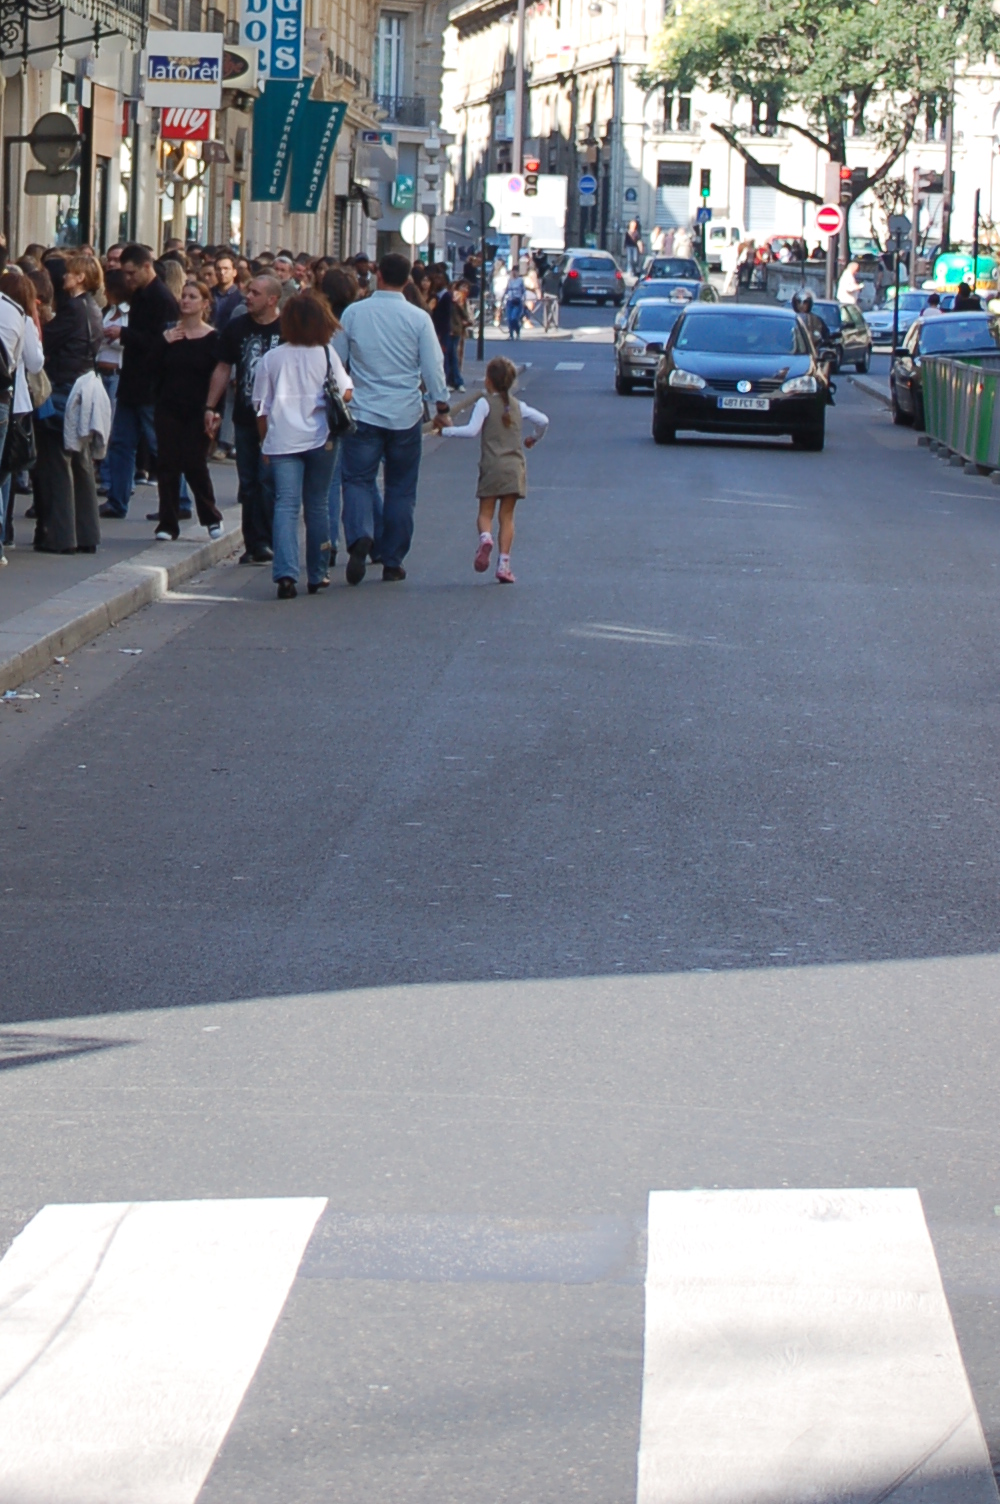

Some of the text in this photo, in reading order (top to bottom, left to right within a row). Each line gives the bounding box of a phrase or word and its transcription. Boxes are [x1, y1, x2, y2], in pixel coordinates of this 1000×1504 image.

[148, 59, 219, 81] laforêt
[269, 82, 305, 194] PARAPHARMACIE
[305, 106, 339, 208] PARAPHARMACIE
